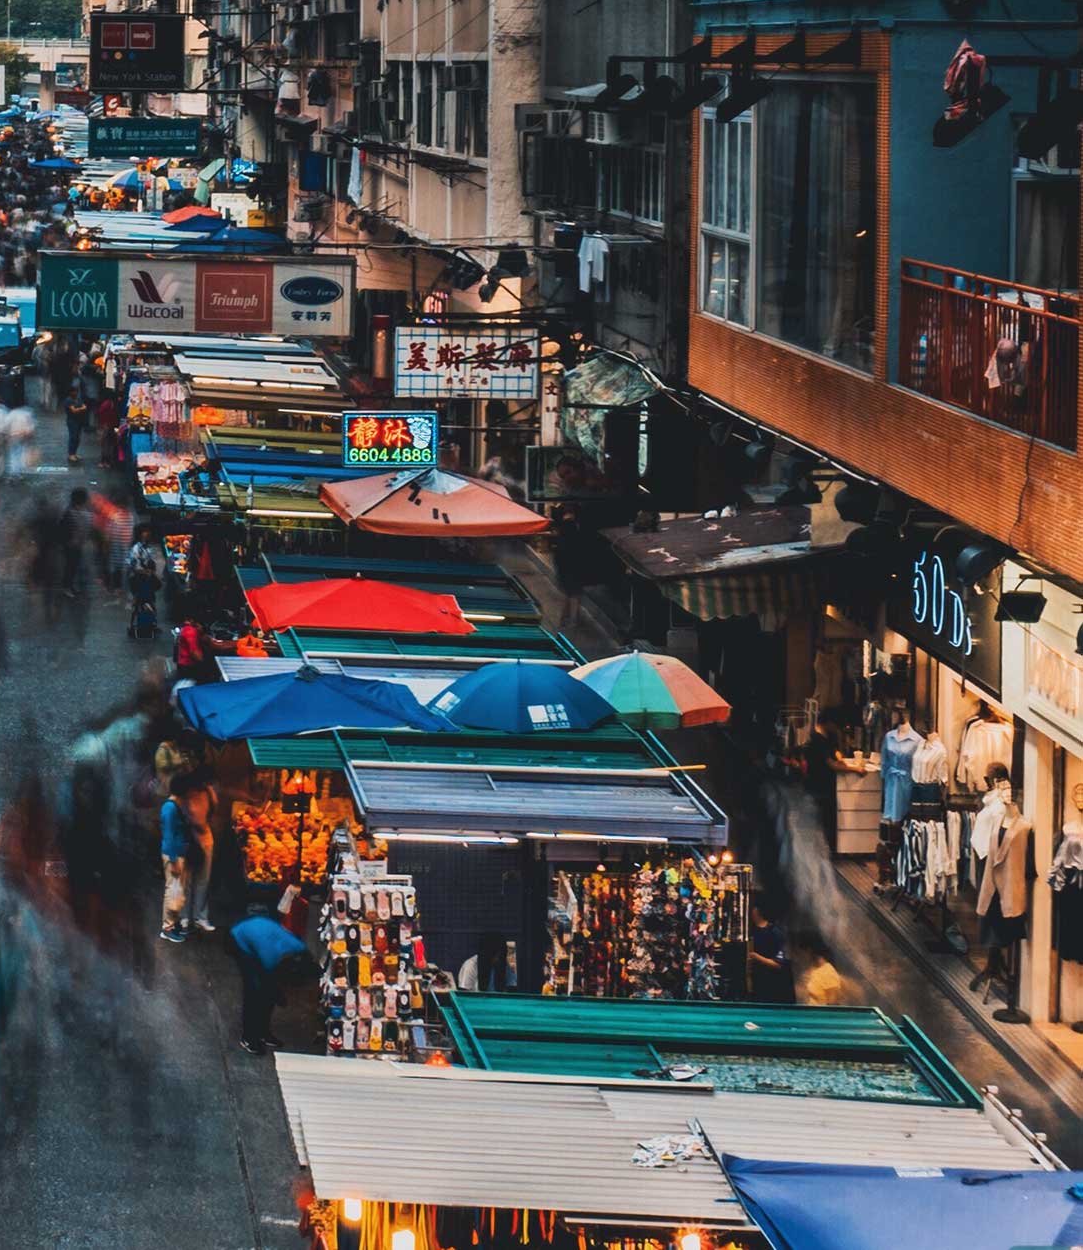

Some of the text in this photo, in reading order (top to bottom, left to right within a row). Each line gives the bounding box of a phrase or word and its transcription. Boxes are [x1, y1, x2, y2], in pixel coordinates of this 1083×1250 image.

[210, 293, 258, 308] Triumph
[128, 304, 184, 319] Wacoal
[349, 448, 432, 462] 6604 4886
